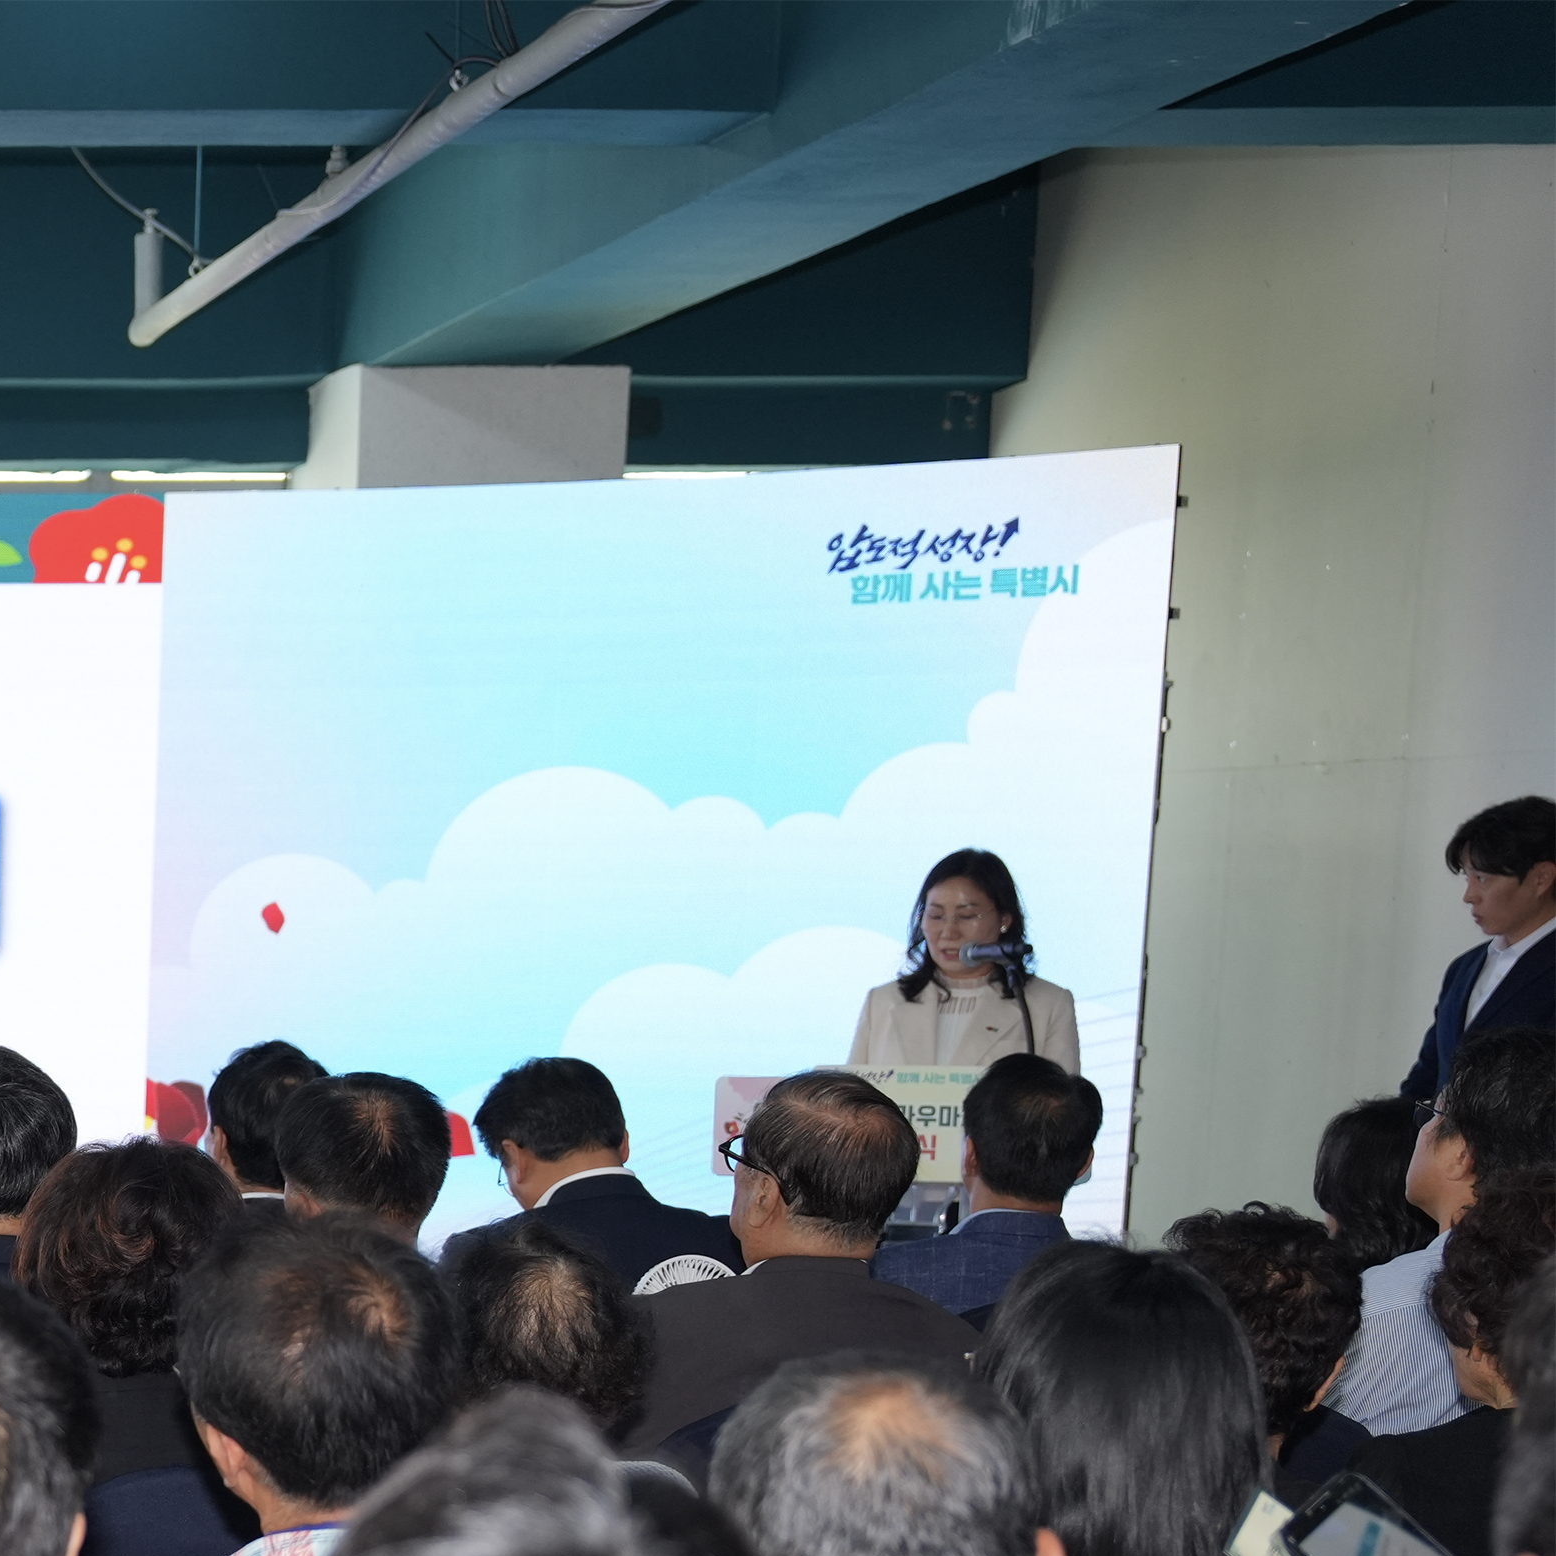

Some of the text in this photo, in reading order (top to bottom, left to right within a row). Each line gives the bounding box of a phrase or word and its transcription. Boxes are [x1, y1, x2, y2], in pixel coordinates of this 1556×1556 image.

[827, 524, 925, 574] 압도적
[850, 565, 1079, 605] 함께 사는 특별시
[922, 1072, 946, 1084] 사는
